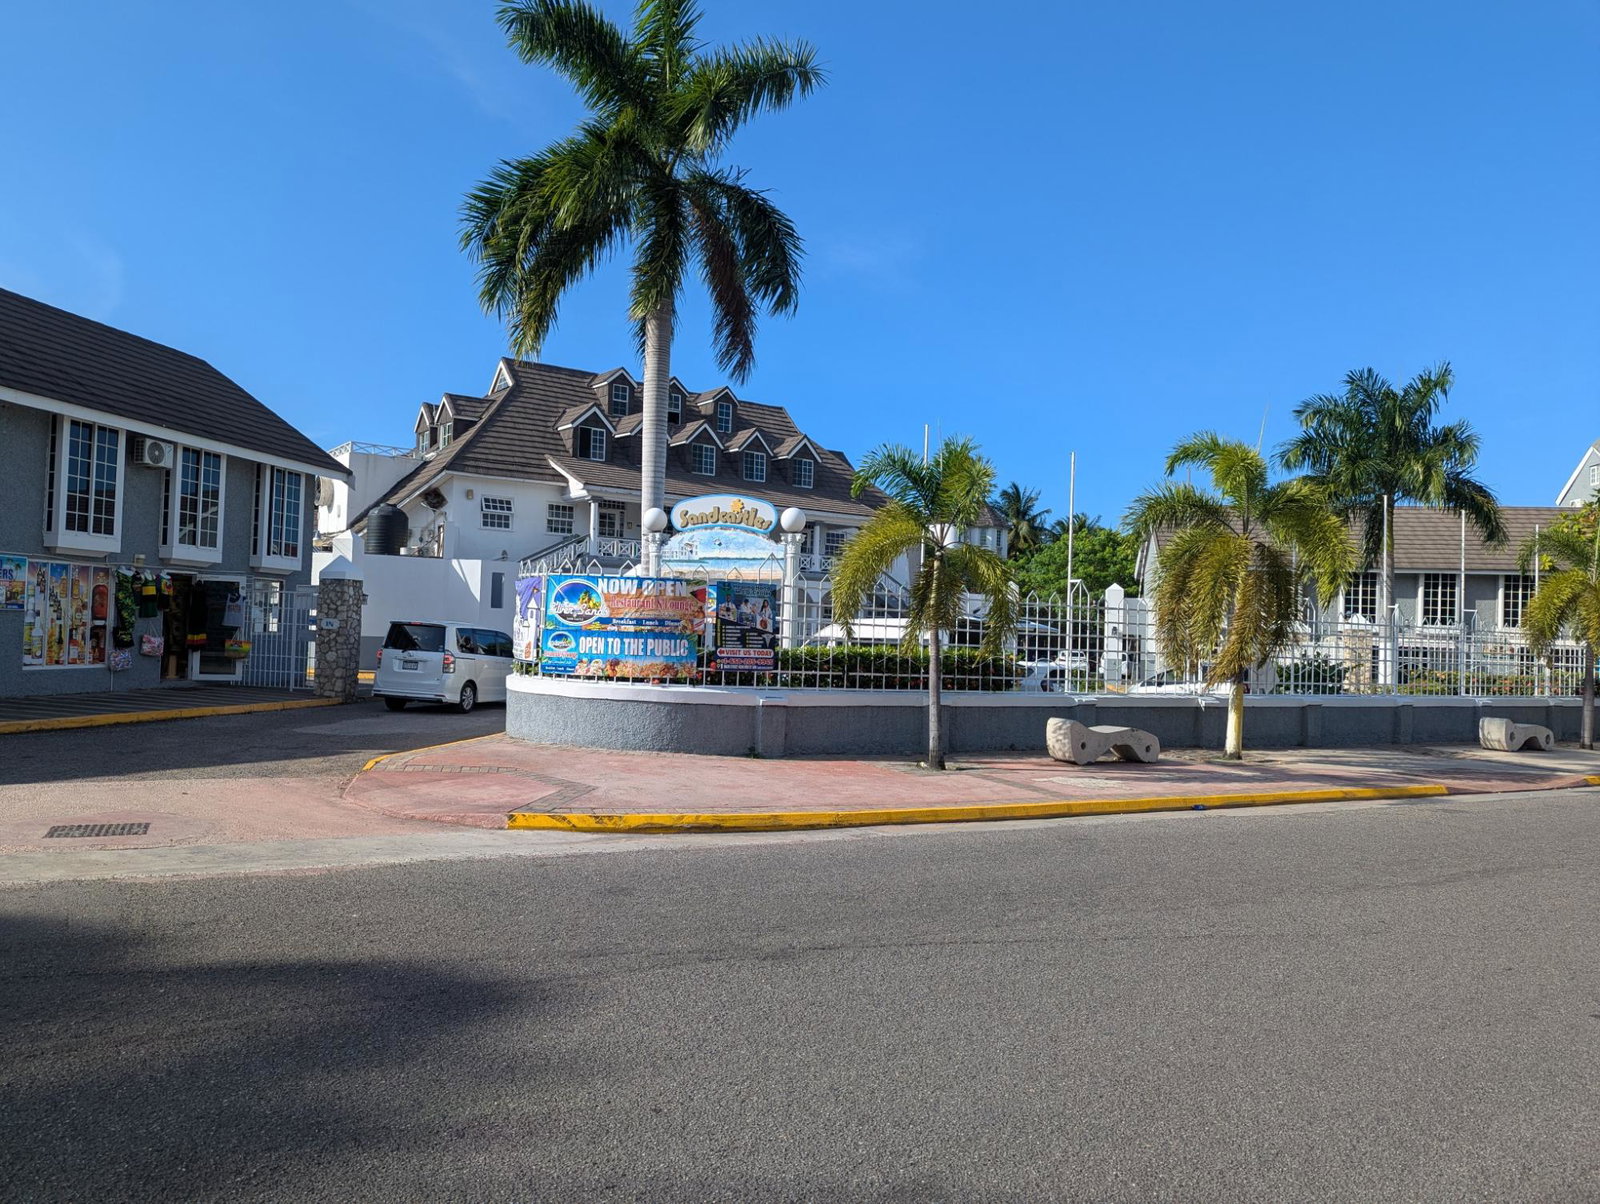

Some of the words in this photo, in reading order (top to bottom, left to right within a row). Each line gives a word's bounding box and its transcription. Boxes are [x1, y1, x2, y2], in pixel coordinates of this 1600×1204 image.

[680, 506, 772, 530] Sandcastles
[598, 578, 638, 595] NOW
[642, 579, 687, 596] OPEN
[610, 596, 655, 610] Restaurant
[579, 636, 604, 655] OPEN
[607, 637, 621, 655] TO
[623, 638, 644, 656] THE
[647, 639, 688, 657] PUBLIC
